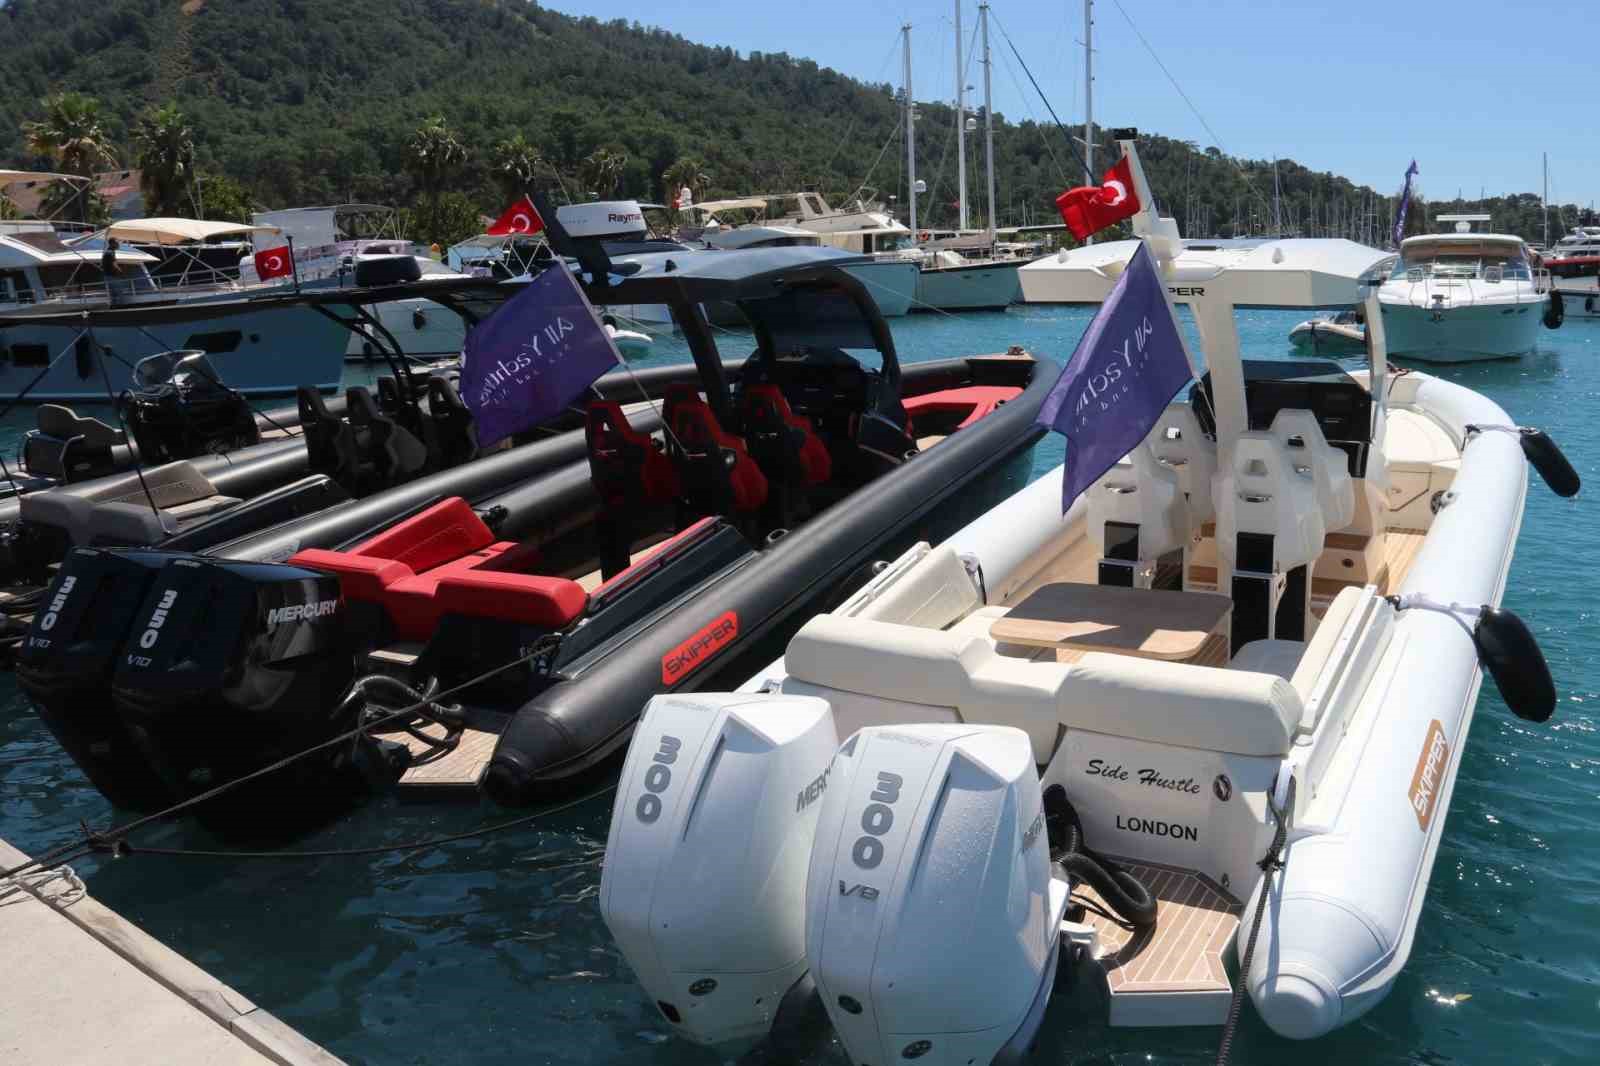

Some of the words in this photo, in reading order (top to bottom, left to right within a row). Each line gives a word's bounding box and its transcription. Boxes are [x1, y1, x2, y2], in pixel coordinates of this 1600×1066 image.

[140, 589, 178, 649] 350
[267, 600, 337, 624] MERCURY
[665, 619, 735, 675] SKIPPER
[635, 735, 682, 825] 300
[1085, 759, 1129, 781] Side
[1137, 768, 1200, 794] Hustle
[1413, 729, 1446, 817] SKIPPER
[852, 771, 903, 870] 300
[1116, 815, 1198, 841] LONDON
